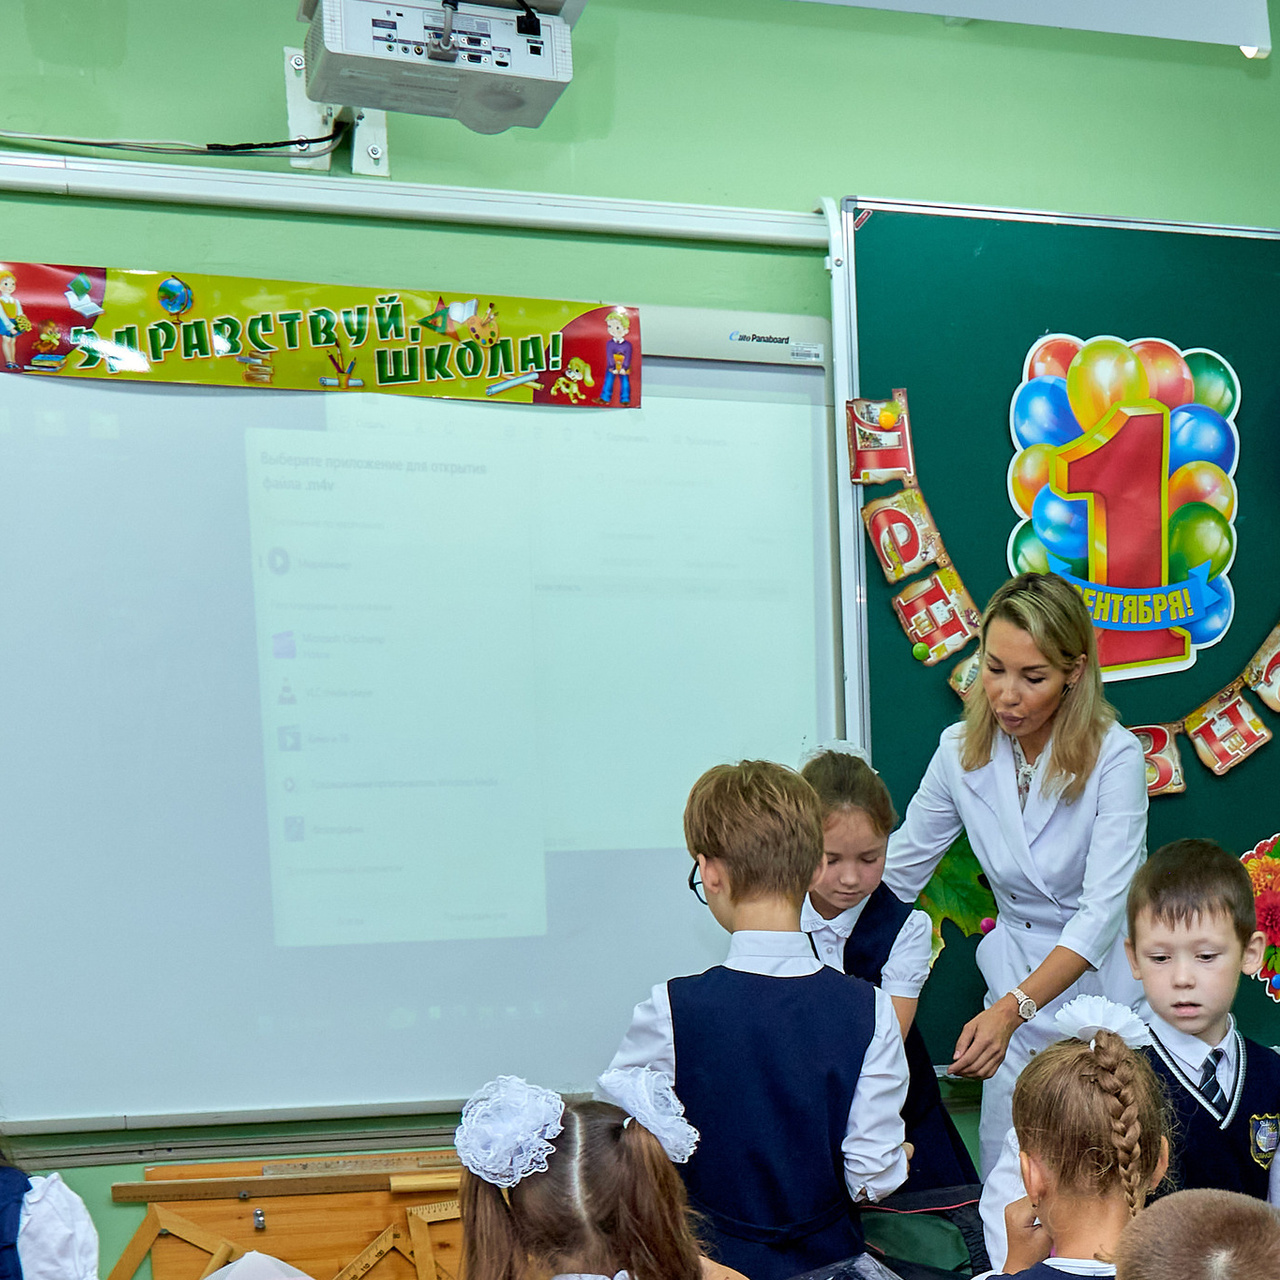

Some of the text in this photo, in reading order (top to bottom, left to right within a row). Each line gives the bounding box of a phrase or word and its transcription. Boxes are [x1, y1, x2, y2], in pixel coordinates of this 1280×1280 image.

[751, 333, 790, 345] Panaboard
[375, 332, 563, 386] ШКОЛА!
[260, 451, 488, 476] Выберите приложение для открытия
[262, 475, 302, 492] файла
[1075, 585, 1195, 624] ЕНТЯБРЯ!
